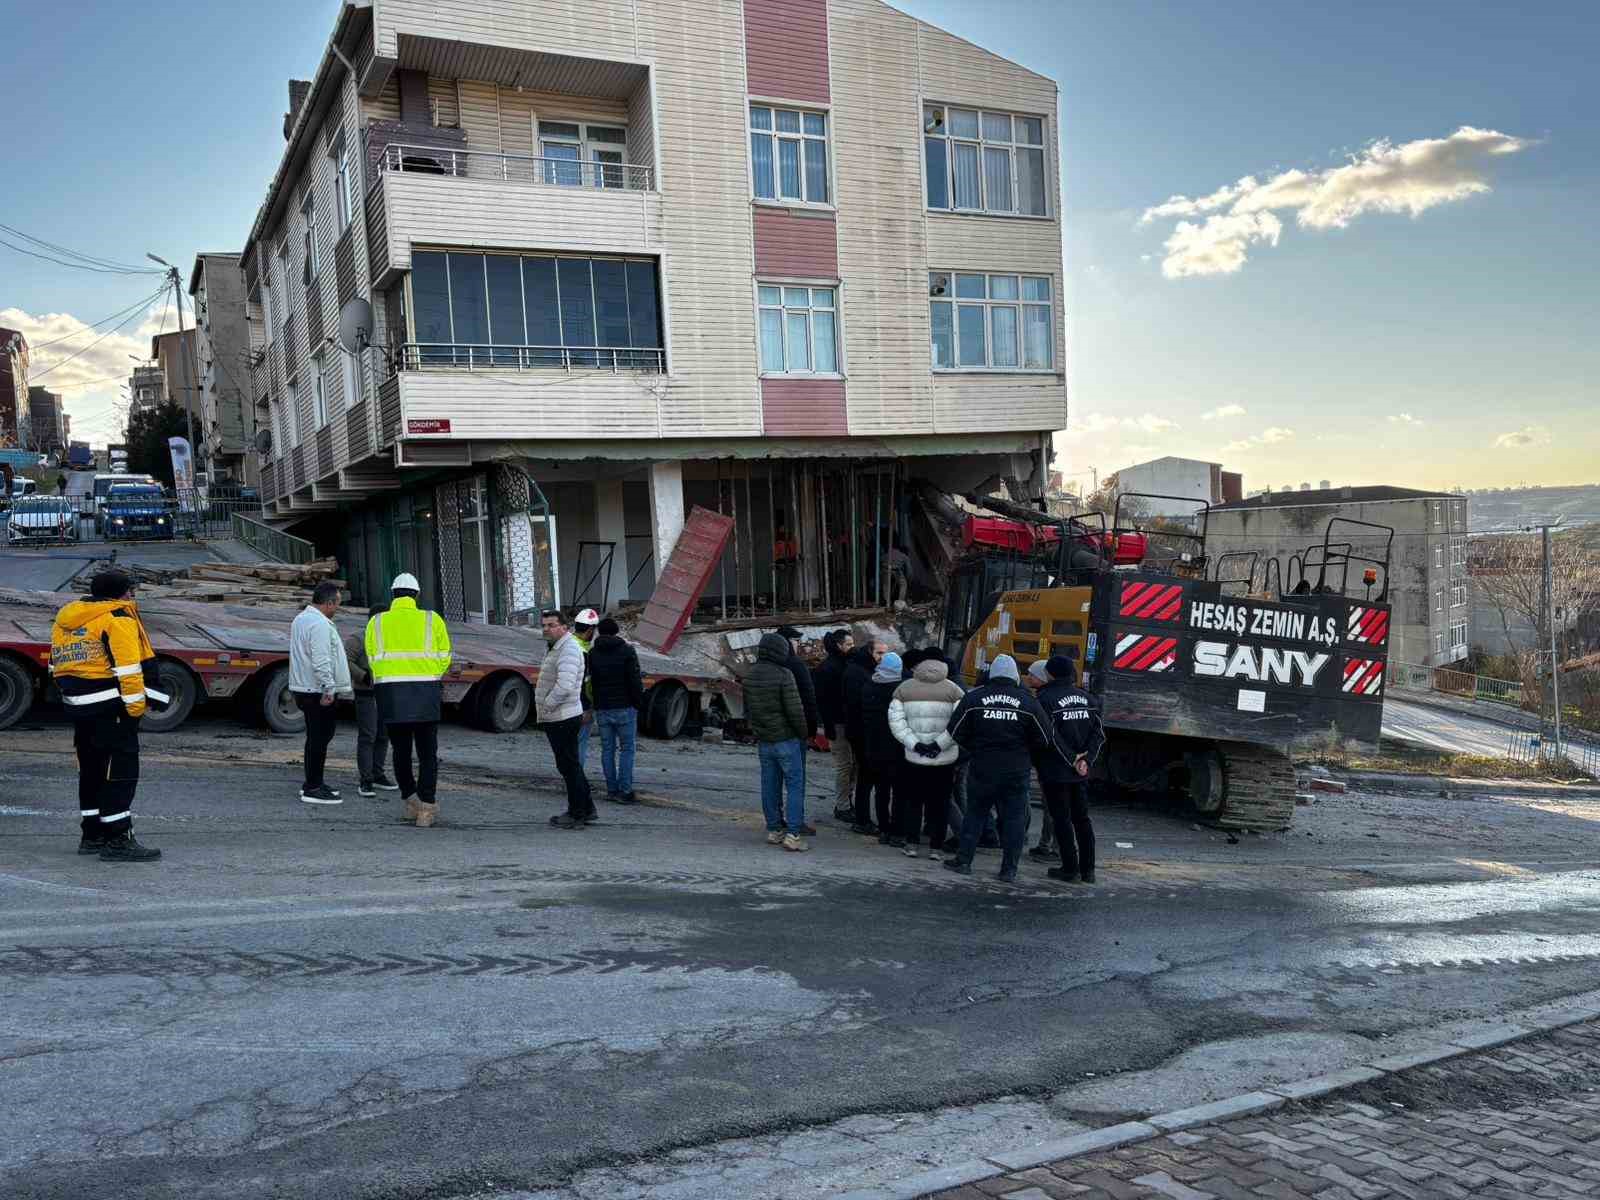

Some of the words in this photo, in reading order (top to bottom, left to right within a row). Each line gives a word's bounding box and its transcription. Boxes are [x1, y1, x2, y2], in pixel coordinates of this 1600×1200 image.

[1190, 601, 1247, 637] HESAŞ
[1250, 608, 1305, 641] ZEMİN
[1308, 619, 1340, 648] A.Ş.
[1193, 640, 1331, 686] SANY
[981, 694, 1021, 708] BAŞAKŞEHİR
[983, 709, 1018, 720] ZABITA
[1062, 710, 1089, 720] ZABITA
